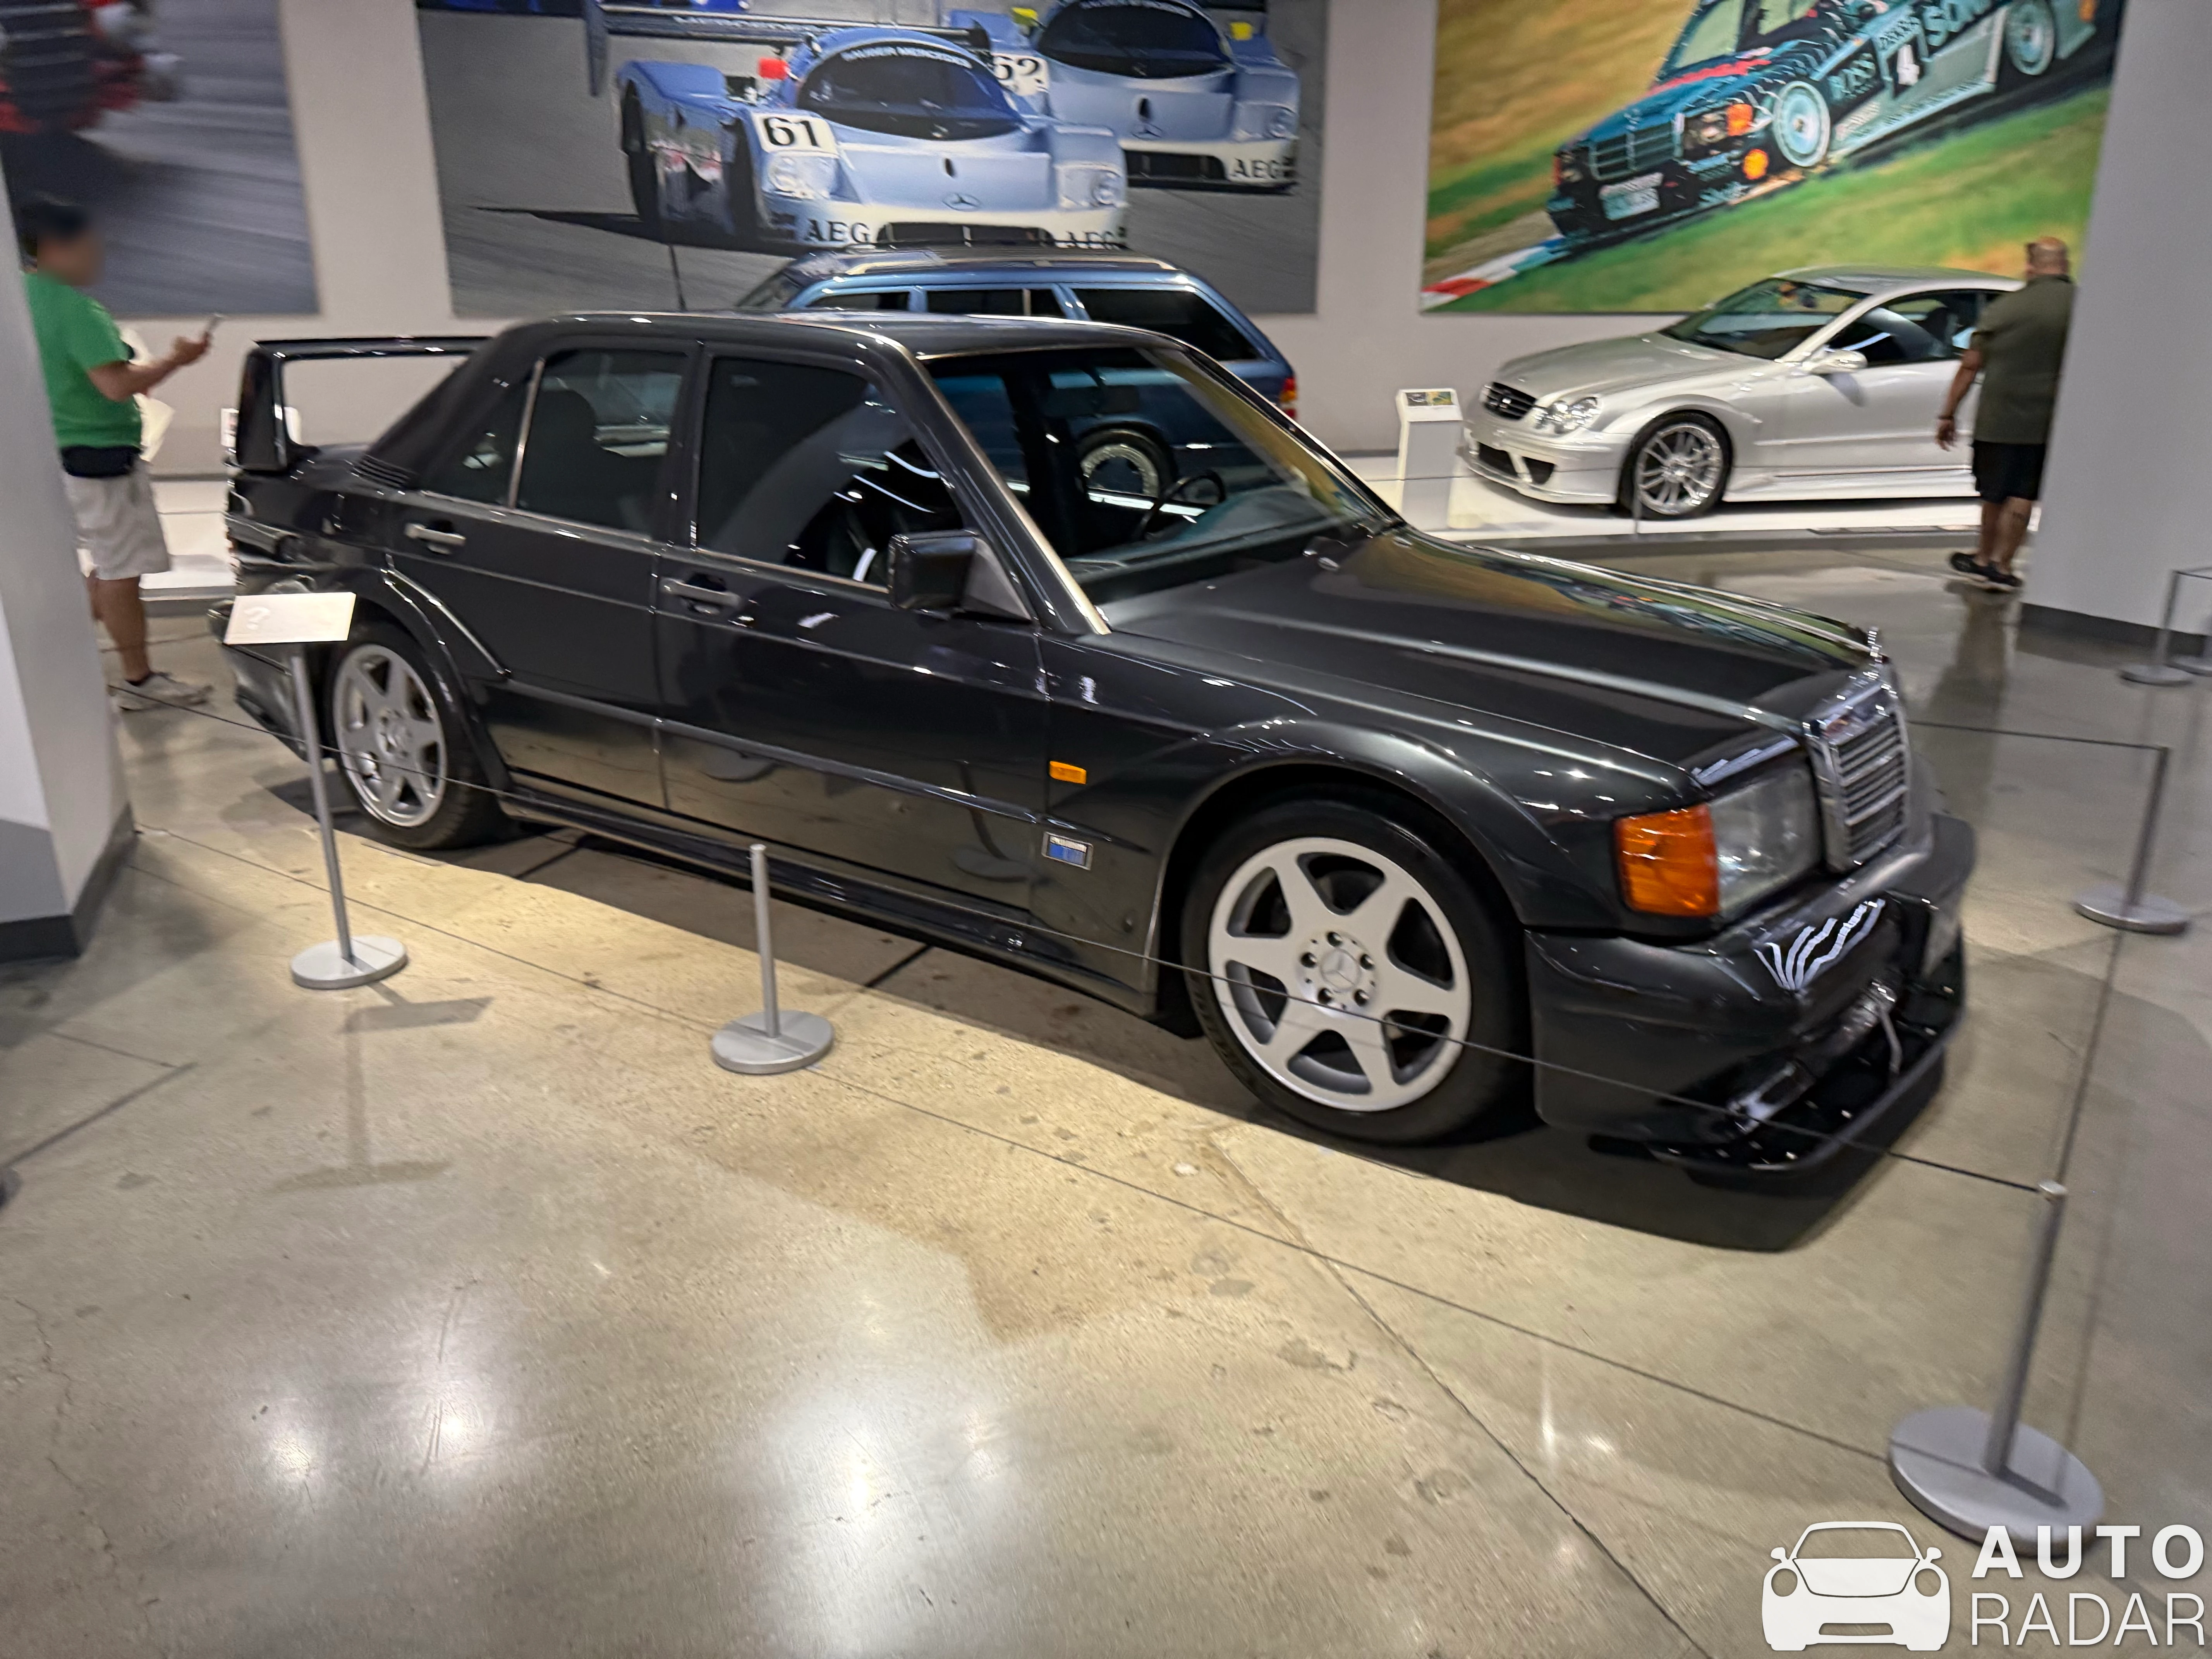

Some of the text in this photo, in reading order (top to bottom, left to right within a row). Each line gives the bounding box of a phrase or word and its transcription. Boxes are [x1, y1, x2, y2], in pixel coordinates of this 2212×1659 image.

[992, 55, 1044, 88] 62
[764, 117, 821, 147] 61
[1228, 158, 1280, 179] AEG
[804, 218, 871, 244] AEG
